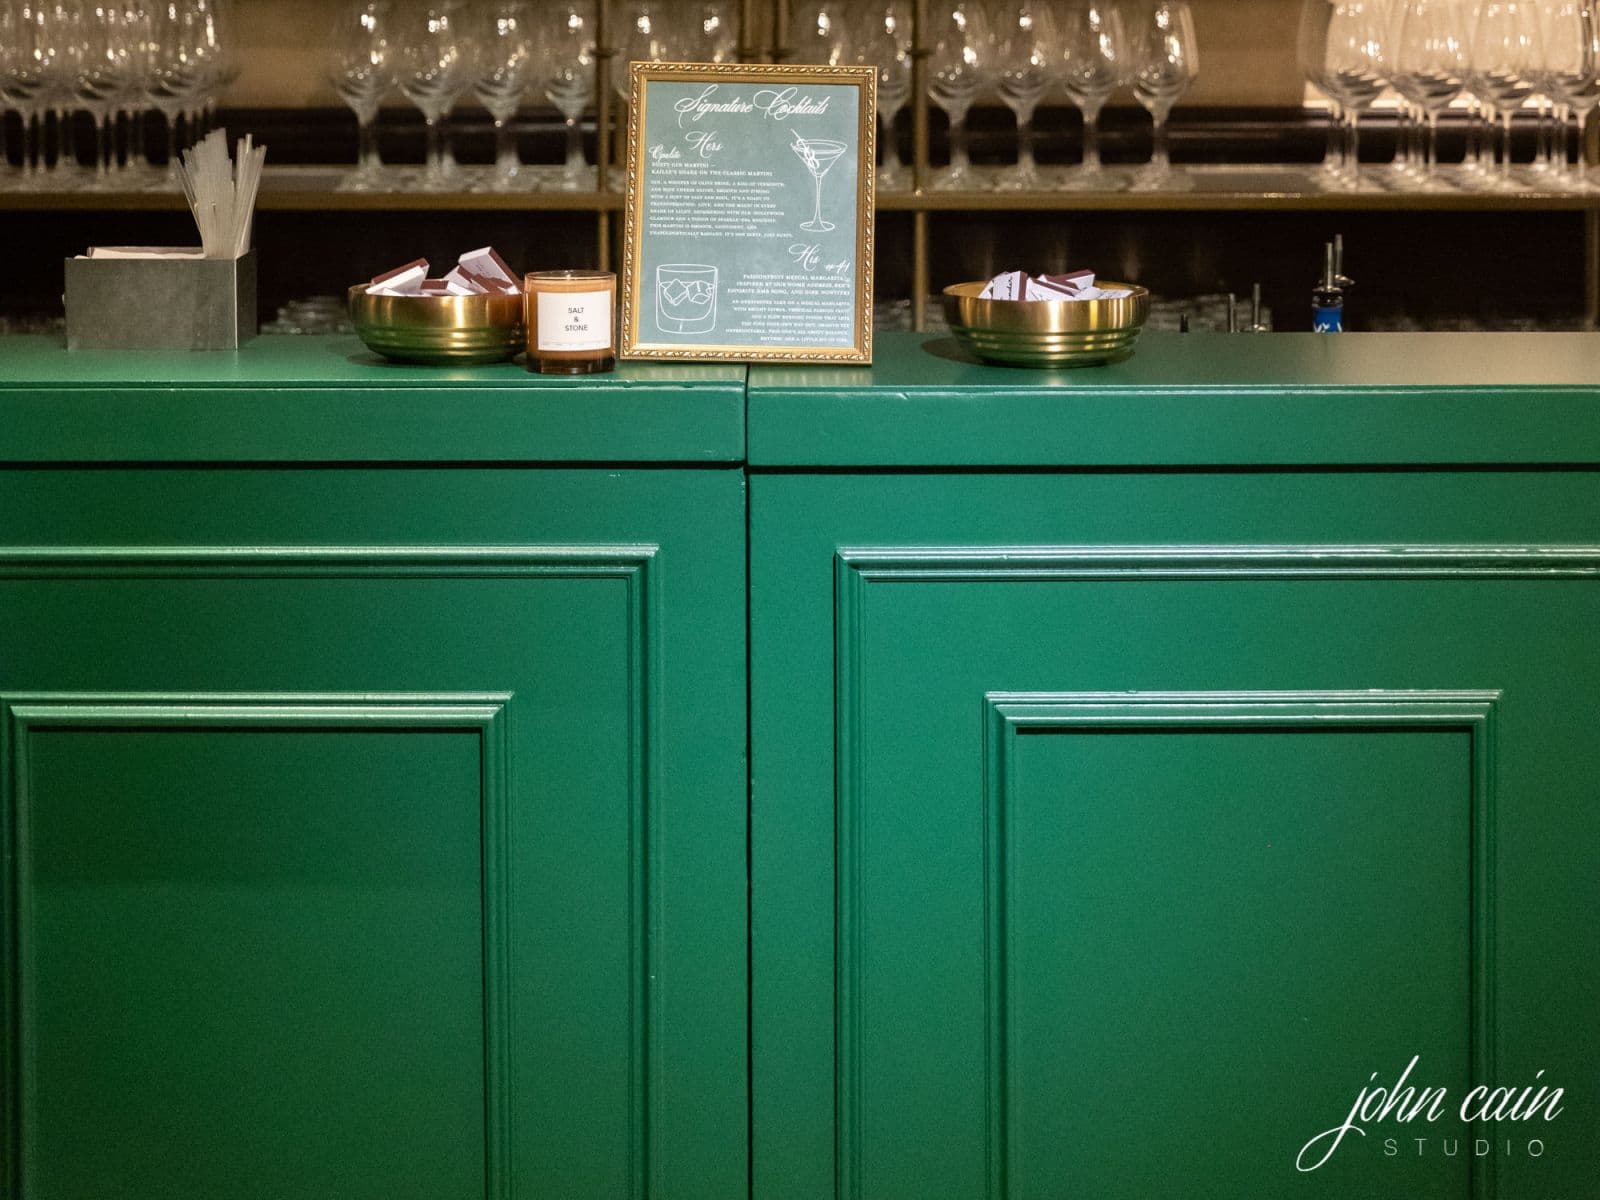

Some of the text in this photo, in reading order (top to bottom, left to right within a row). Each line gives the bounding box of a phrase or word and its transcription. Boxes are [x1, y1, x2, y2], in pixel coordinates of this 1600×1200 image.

[674, 84, 831, 128] Signature Cocktails
[685, 131, 723, 158] Hers
[788, 243, 822, 271] His
